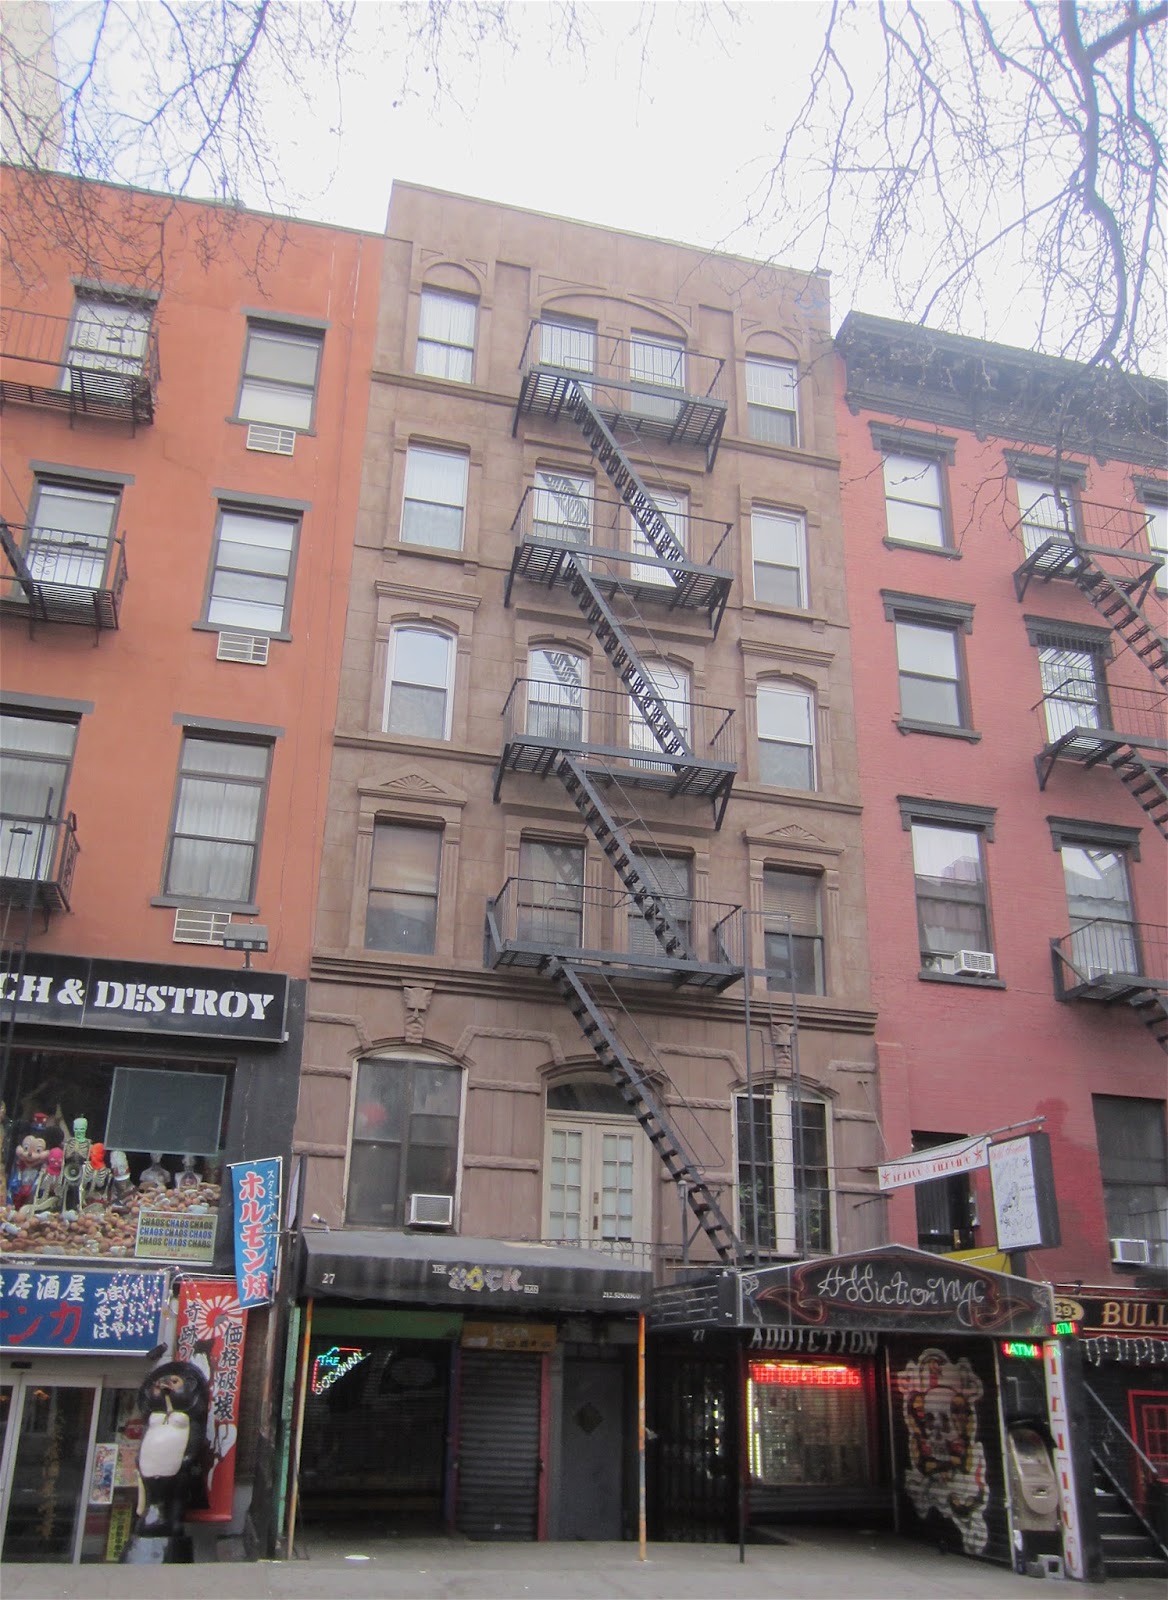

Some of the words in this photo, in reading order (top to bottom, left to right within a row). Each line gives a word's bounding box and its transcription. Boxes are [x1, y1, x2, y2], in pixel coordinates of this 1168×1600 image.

[57, 979, 85, 1005] &
[94, 981, 274, 1020] DESTROY
[141, 1218, 165, 1227] CHAOS
[167, 1219, 189, 1228] CHAOS
[190, 1221, 213, 1229] CHAOS
[140, 1227, 164, 1236] CHAOS
[165, 1228, 188, 1237] CHAOS
[189, 1230, 212, 1239] CHAOS
[139, 1237, 162, 1246] CHAOS
[164, 1238, 187, 1247] CHAOS
[188, 1239, 211, 1248] CHAOS
[432, 1264, 447, 1275] THE
[321, 1273, 336, 1286] 27
[1055, 1304, 1073, 1317] 29
[1101, 1301, 1168, 1327] BULL
[1055, 1322, 1073, 1335] ATM
[692, 1329, 706, 1342] 27
[749, 1327, 879, 1354] ADDICTION
[1009, 1342, 1036, 1359] ATM
[318, 1354, 340, 1366] THE
[214, 1322, 244, 1420] 価格破壊
